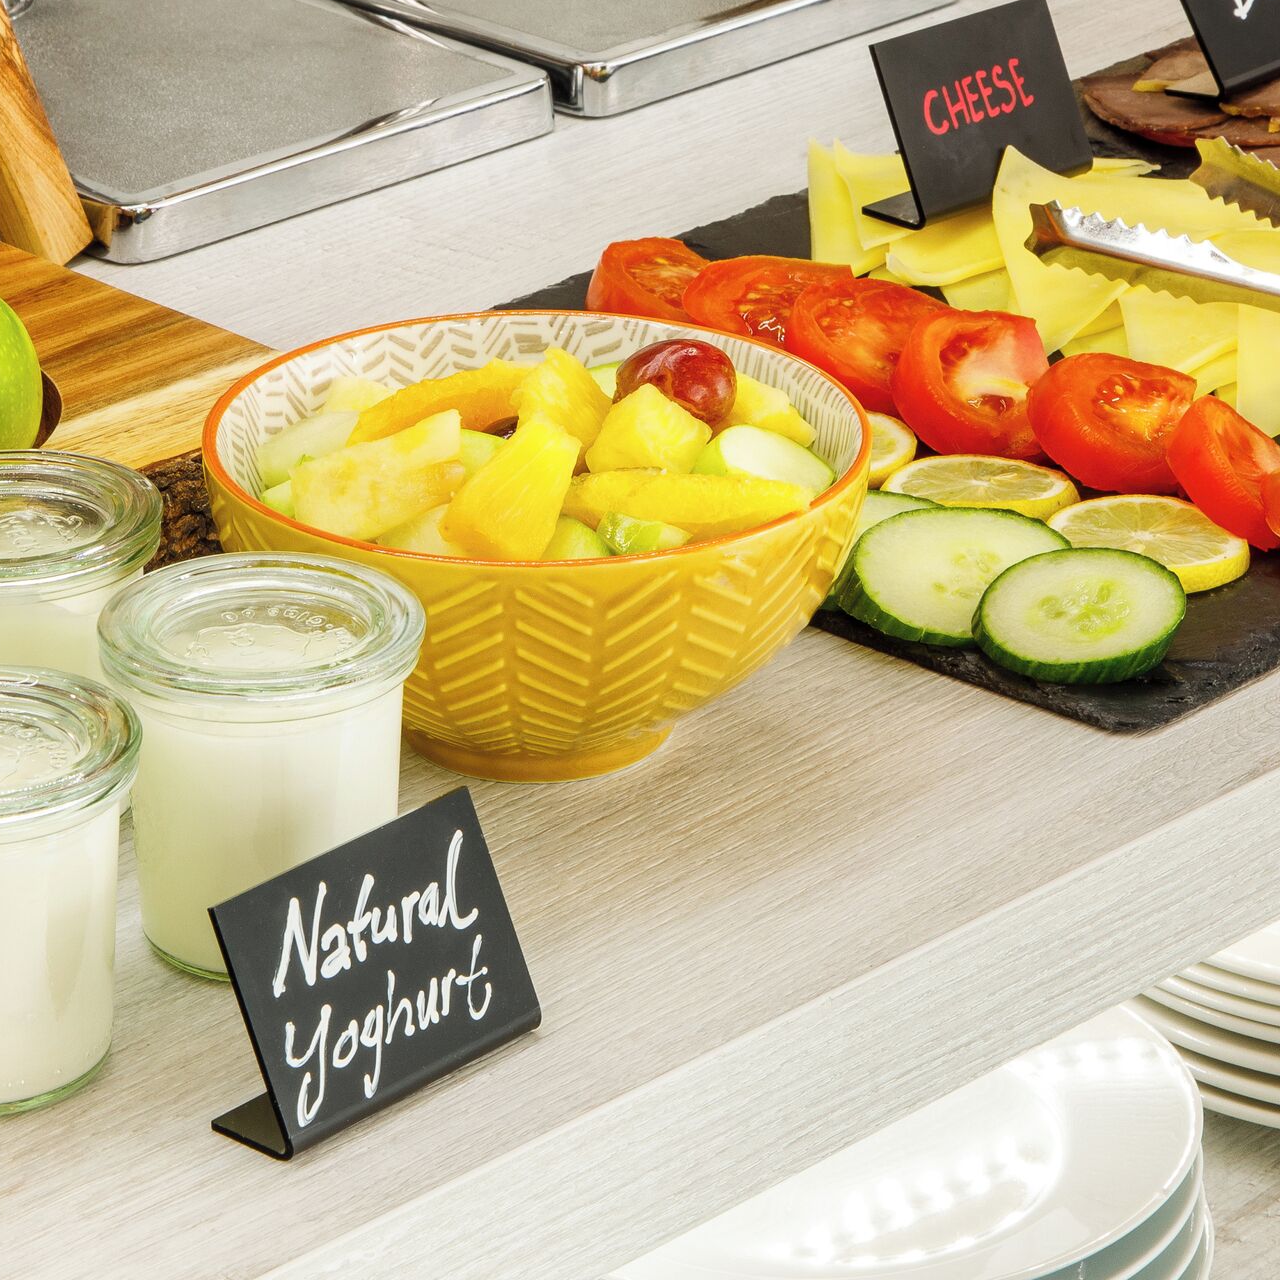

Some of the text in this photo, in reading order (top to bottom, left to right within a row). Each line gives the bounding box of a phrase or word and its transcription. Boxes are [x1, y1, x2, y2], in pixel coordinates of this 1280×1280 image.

[923, 58, 1035, 135] CHEESE
[272, 829, 479, 998] Natural
[286, 934, 492, 1127] Yoghurt
